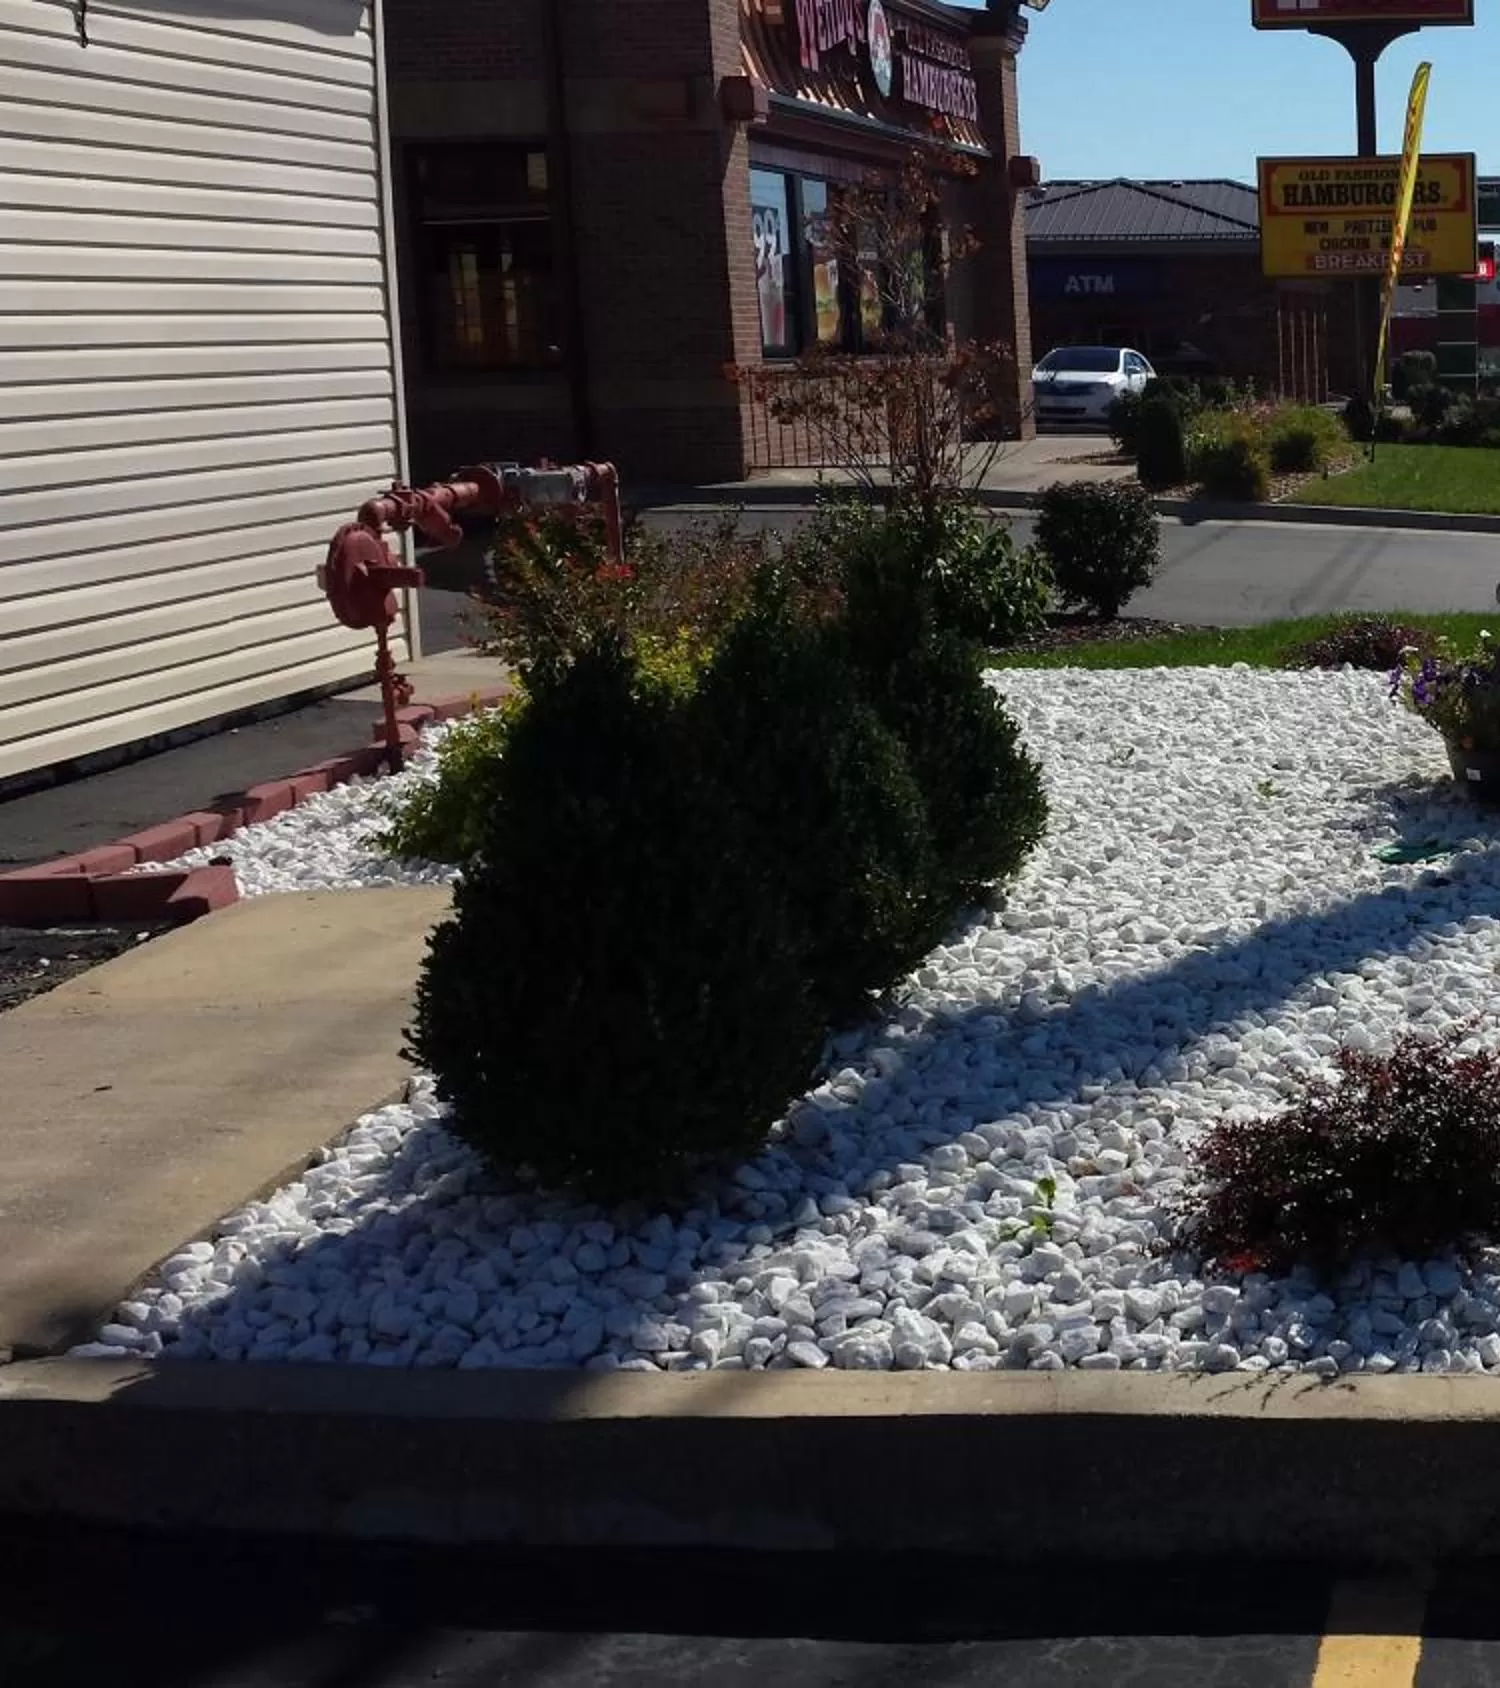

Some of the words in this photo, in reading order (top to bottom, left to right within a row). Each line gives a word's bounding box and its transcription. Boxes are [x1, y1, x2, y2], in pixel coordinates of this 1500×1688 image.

[795, 0, 868, 71] WENDYS
[902, 54, 978, 122] HAMBURGERS
[1298, 168, 1329, 181] OLD
[1334, 167, 1422, 181] FASHIOND
[1283, 181, 1441, 207] HAMBURGRS
[1315, 254, 1425, 270] BREAKFST
[1064, 275, 1115, 293] ATM
